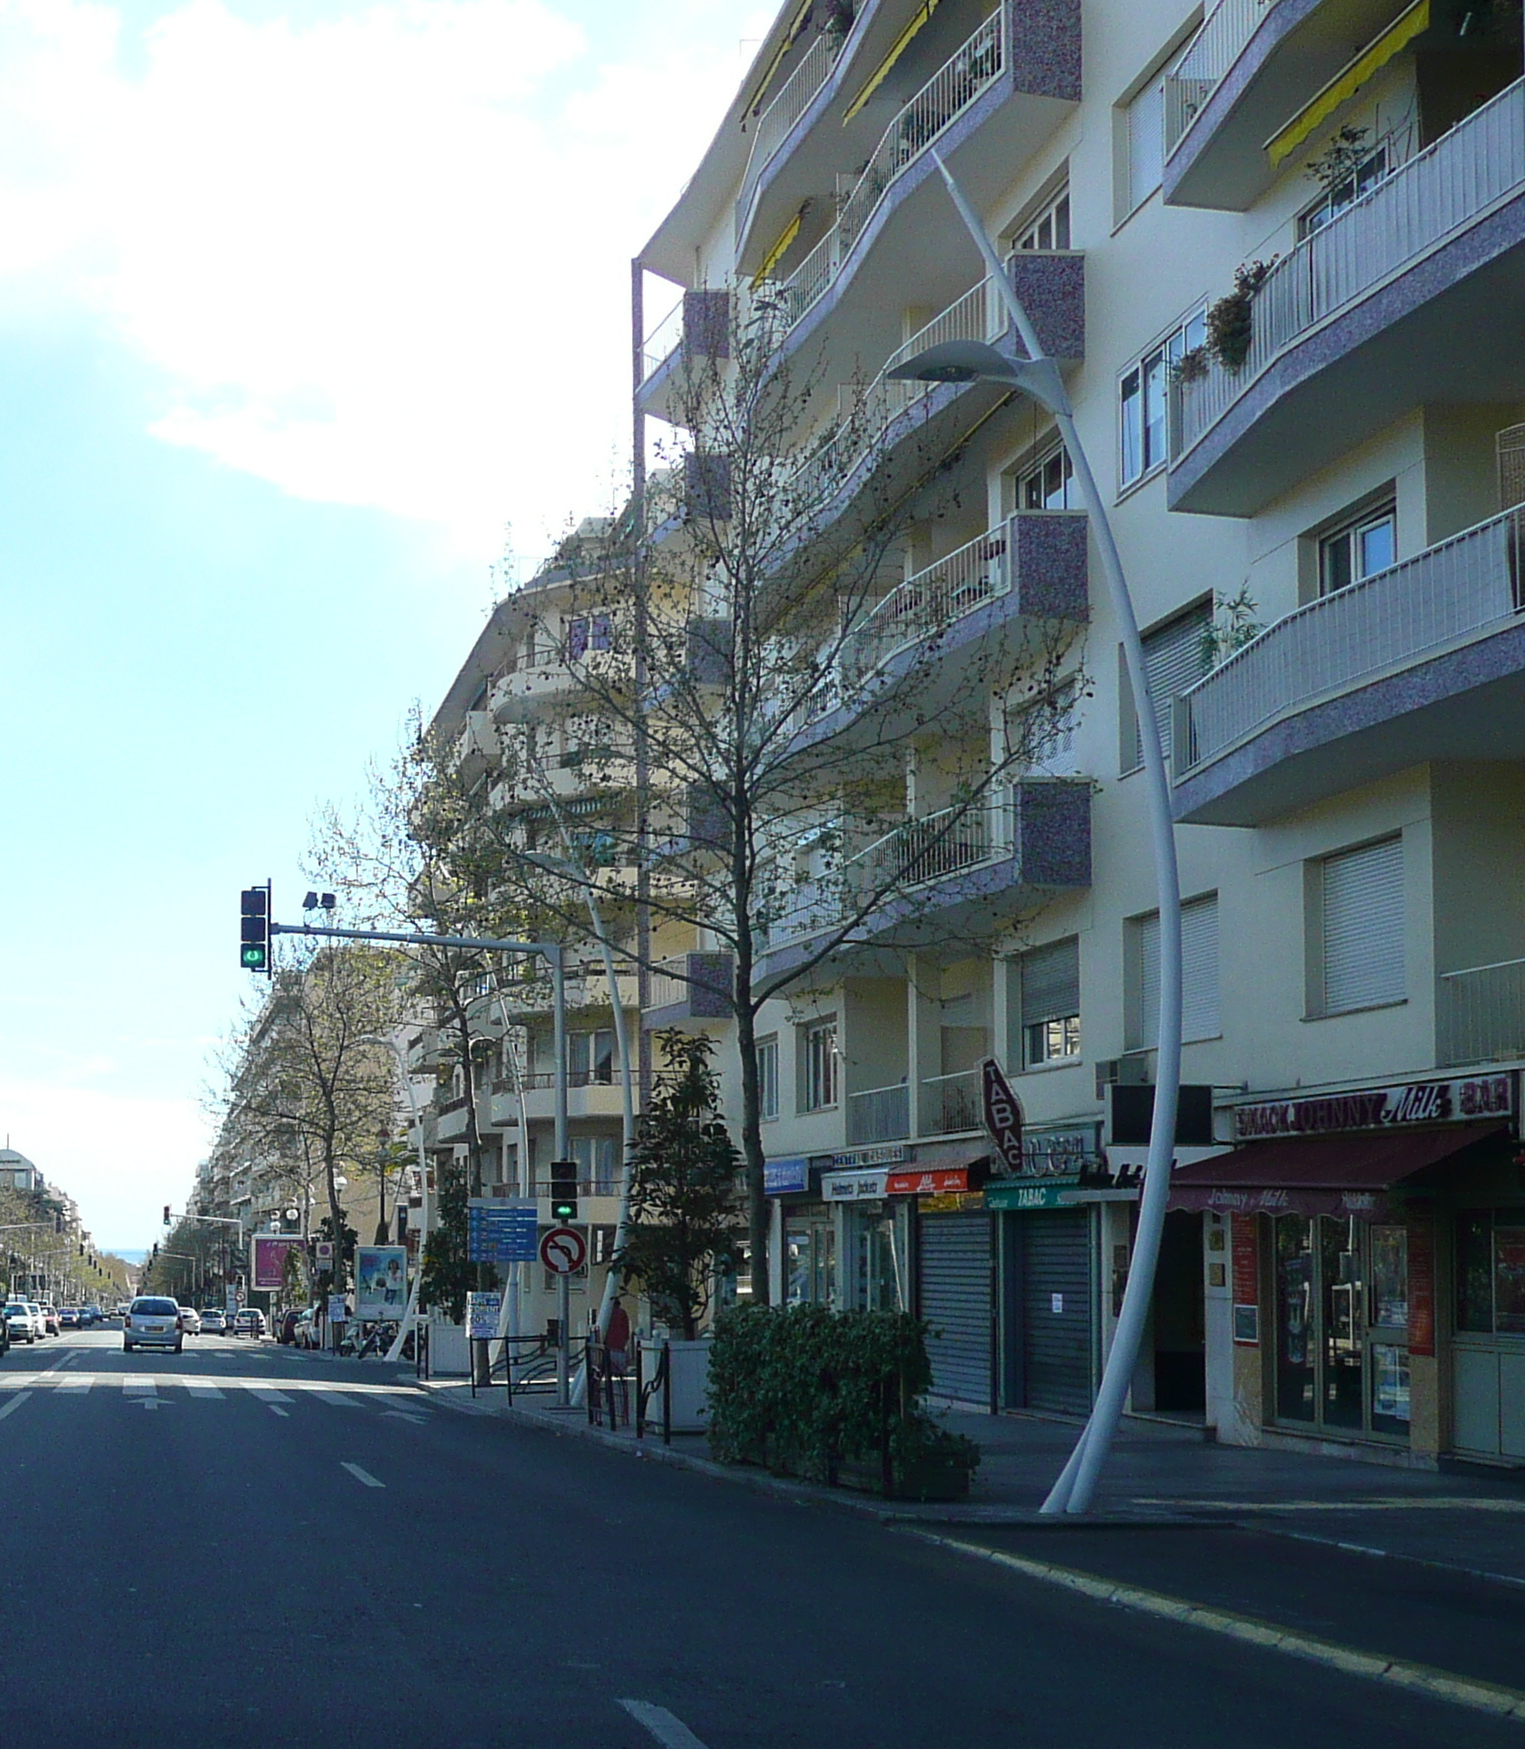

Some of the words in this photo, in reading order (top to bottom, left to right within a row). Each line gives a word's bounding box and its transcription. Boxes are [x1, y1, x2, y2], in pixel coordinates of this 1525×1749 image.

[985, 1065, 1021, 1165] TABAC
[1291, 1095, 1378, 1131] JOHNNY
[1380, 1085, 1443, 1123] Milk
[1017, 1187, 1047, 1207] TABAC
[1207, 1188, 1249, 1209] Johnny
